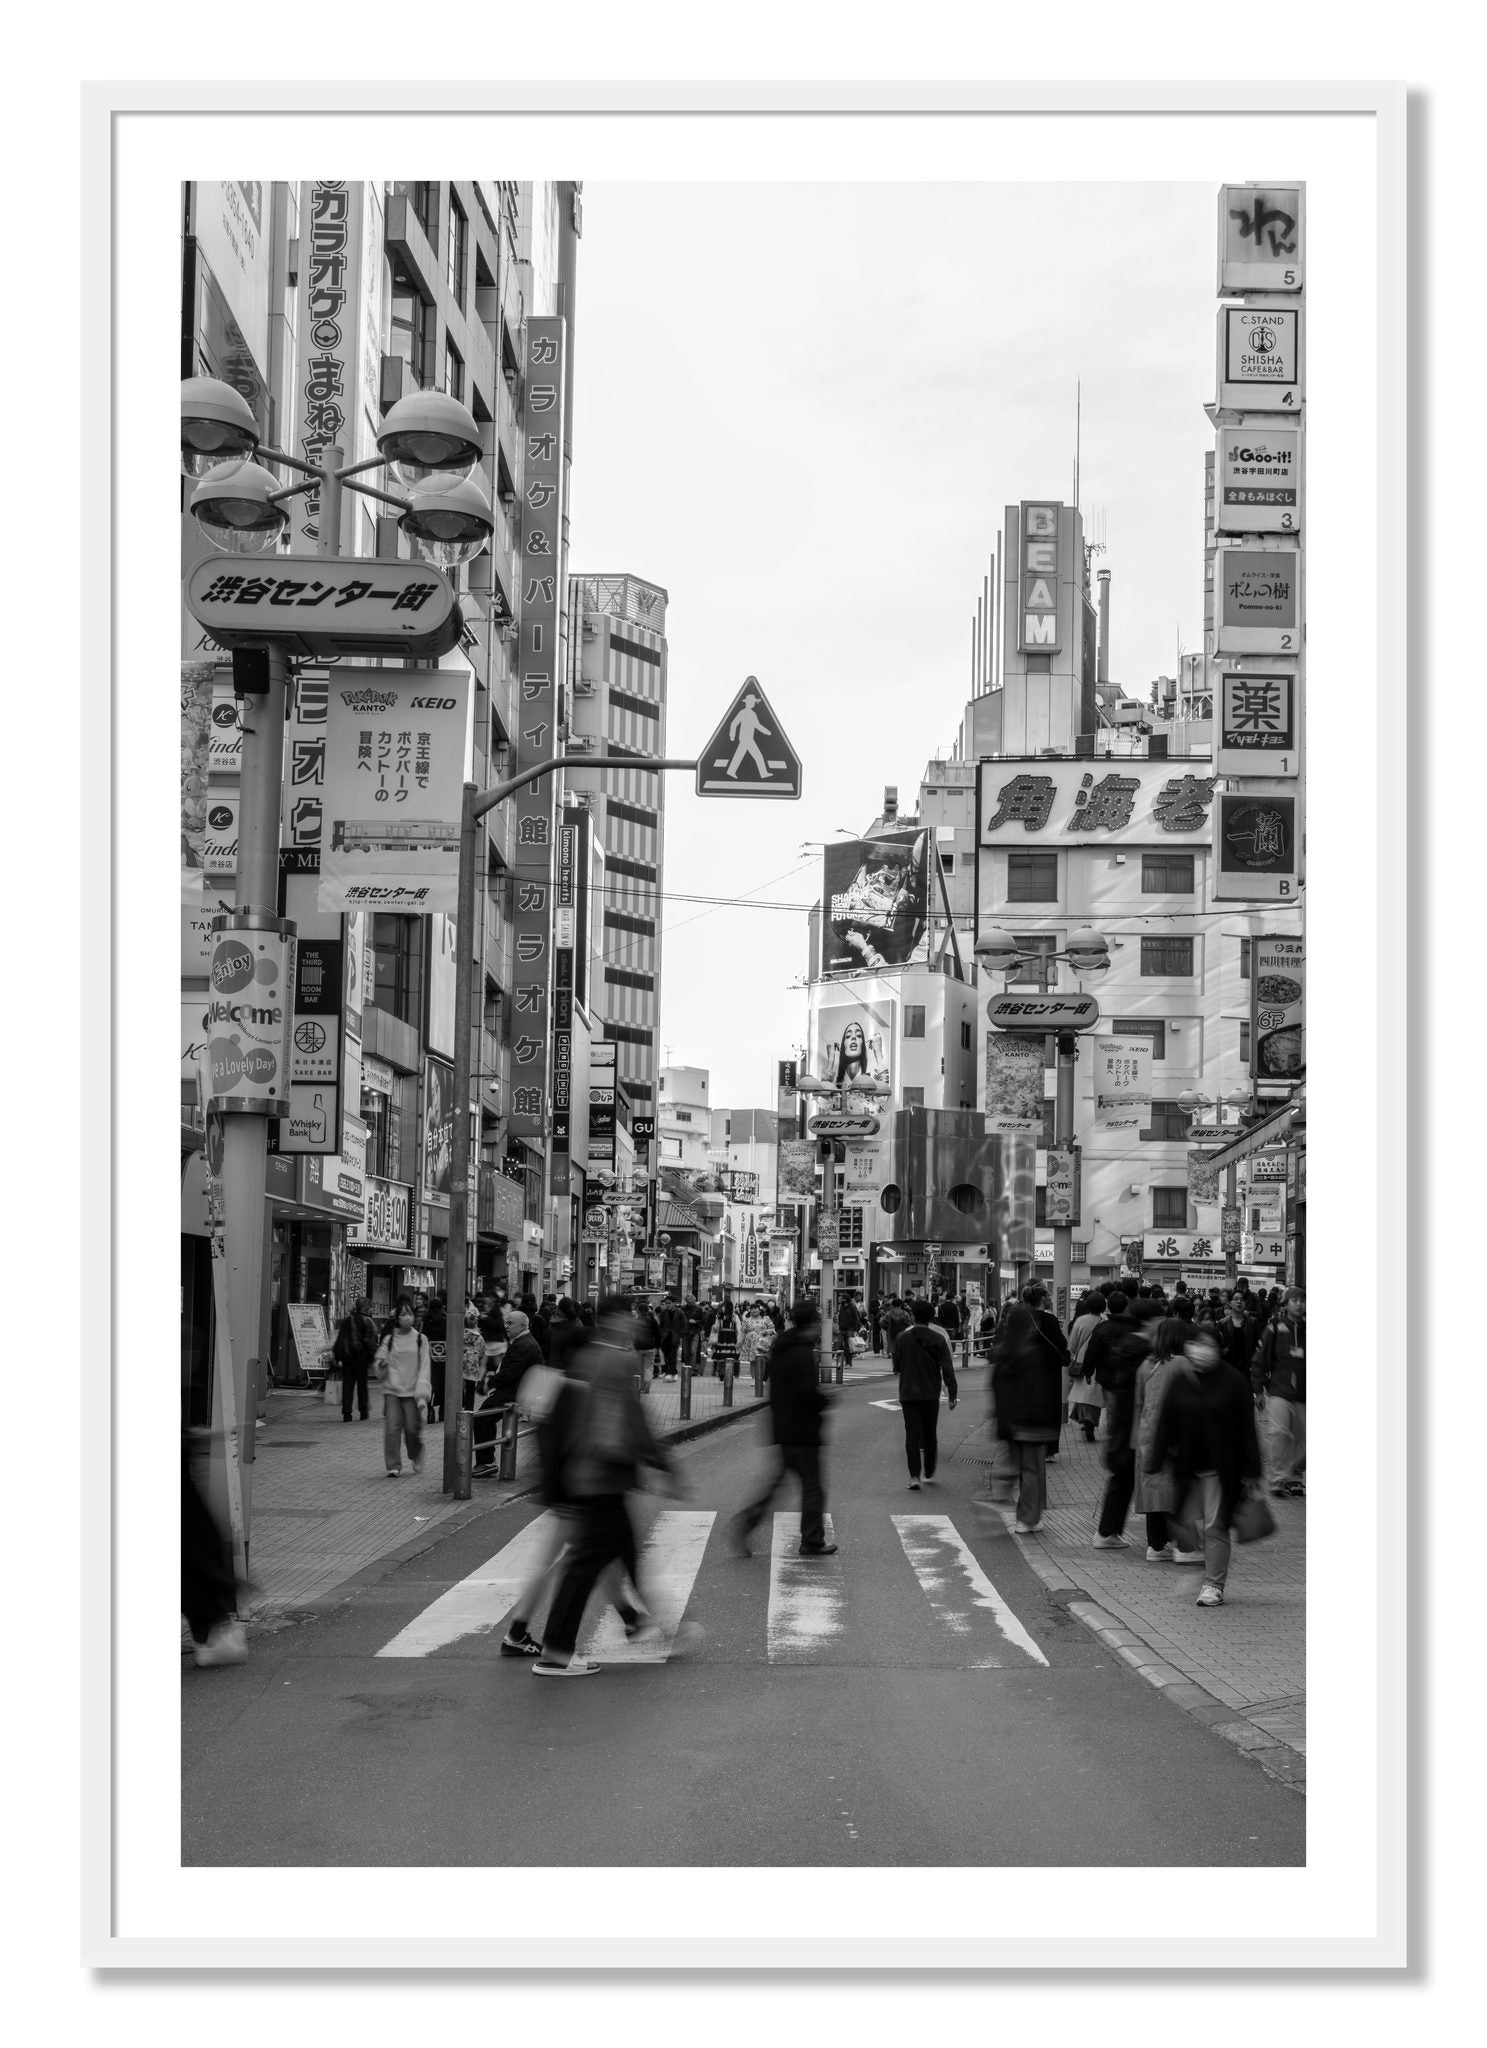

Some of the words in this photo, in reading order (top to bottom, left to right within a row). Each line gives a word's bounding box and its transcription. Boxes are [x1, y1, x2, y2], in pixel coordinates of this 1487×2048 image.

[309, 189, 348, 326] カラオケ
[1284, 271, 1295, 284] 5
[1241, 316, 1284, 325] C.STAND
[1241, 355, 1283, 365] SHISHA
[1240, 448, 1291, 463] Goo-it!
[1233, 467, 1288, 475] 渋谷宇田川町店
[1228, 491, 1292, 502] 全身もみほぐし
[1282, 513, 1293, 528] 3
[1025, 506, 1057, 645] BEAM
[200, 575, 439, 611] 渋谷センター街
[1229, 581, 1290, 600] ポムの樹
[1239, 603, 1282, 611] Pomme-no-ki
[1281, 635, 1292, 649] 2
[353, 704, 386, 712] KANTO
[410, 697, 457, 710] KEIO
[1232, 681, 1280, 729] 薬
[357, 731, 373, 772] 冒険へ
[213, 757, 237, 766] 渋谷店
[375, 732, 392, 803] カントーの
[395, 732, 412, 803] ポケパーク
[415, 732, 431, 789] 京王線で
[1281, 758, 1288, 772] 1
[988, 773, 1216, 832] 角海老
[562, 831, 571, 864] kimono
[209, 860, 233, 869] 渋谷店
[562, 869, 570, 902] hearts
[1279, 880, 1290, 895] B
[345, 887, 430, 899] 渋谷センター街
[1259, 955, 1301, 968] 四川料理
[213, 953, 252, 987] Enjoy
[209, 1001, 282, 1025] Welcome
[994, 1002, 1092, 1015] 渋谷センター街
[1258, 1011, 1285, 1030] 6F
[225, 1057, 254, 1075] Lovely
[256, 1057, 274, 1071] Day!
[290, 1120, 322, 1130] Whisky
[634, 1122, 654, 1133] GU
[812, 1119, 871, 1128] 渋谷センター街
[289, 1128, 308, 1137] Bank
[1047, 1181, 1072, 1190] come
[747, 1236, 756, 1276] BEER
